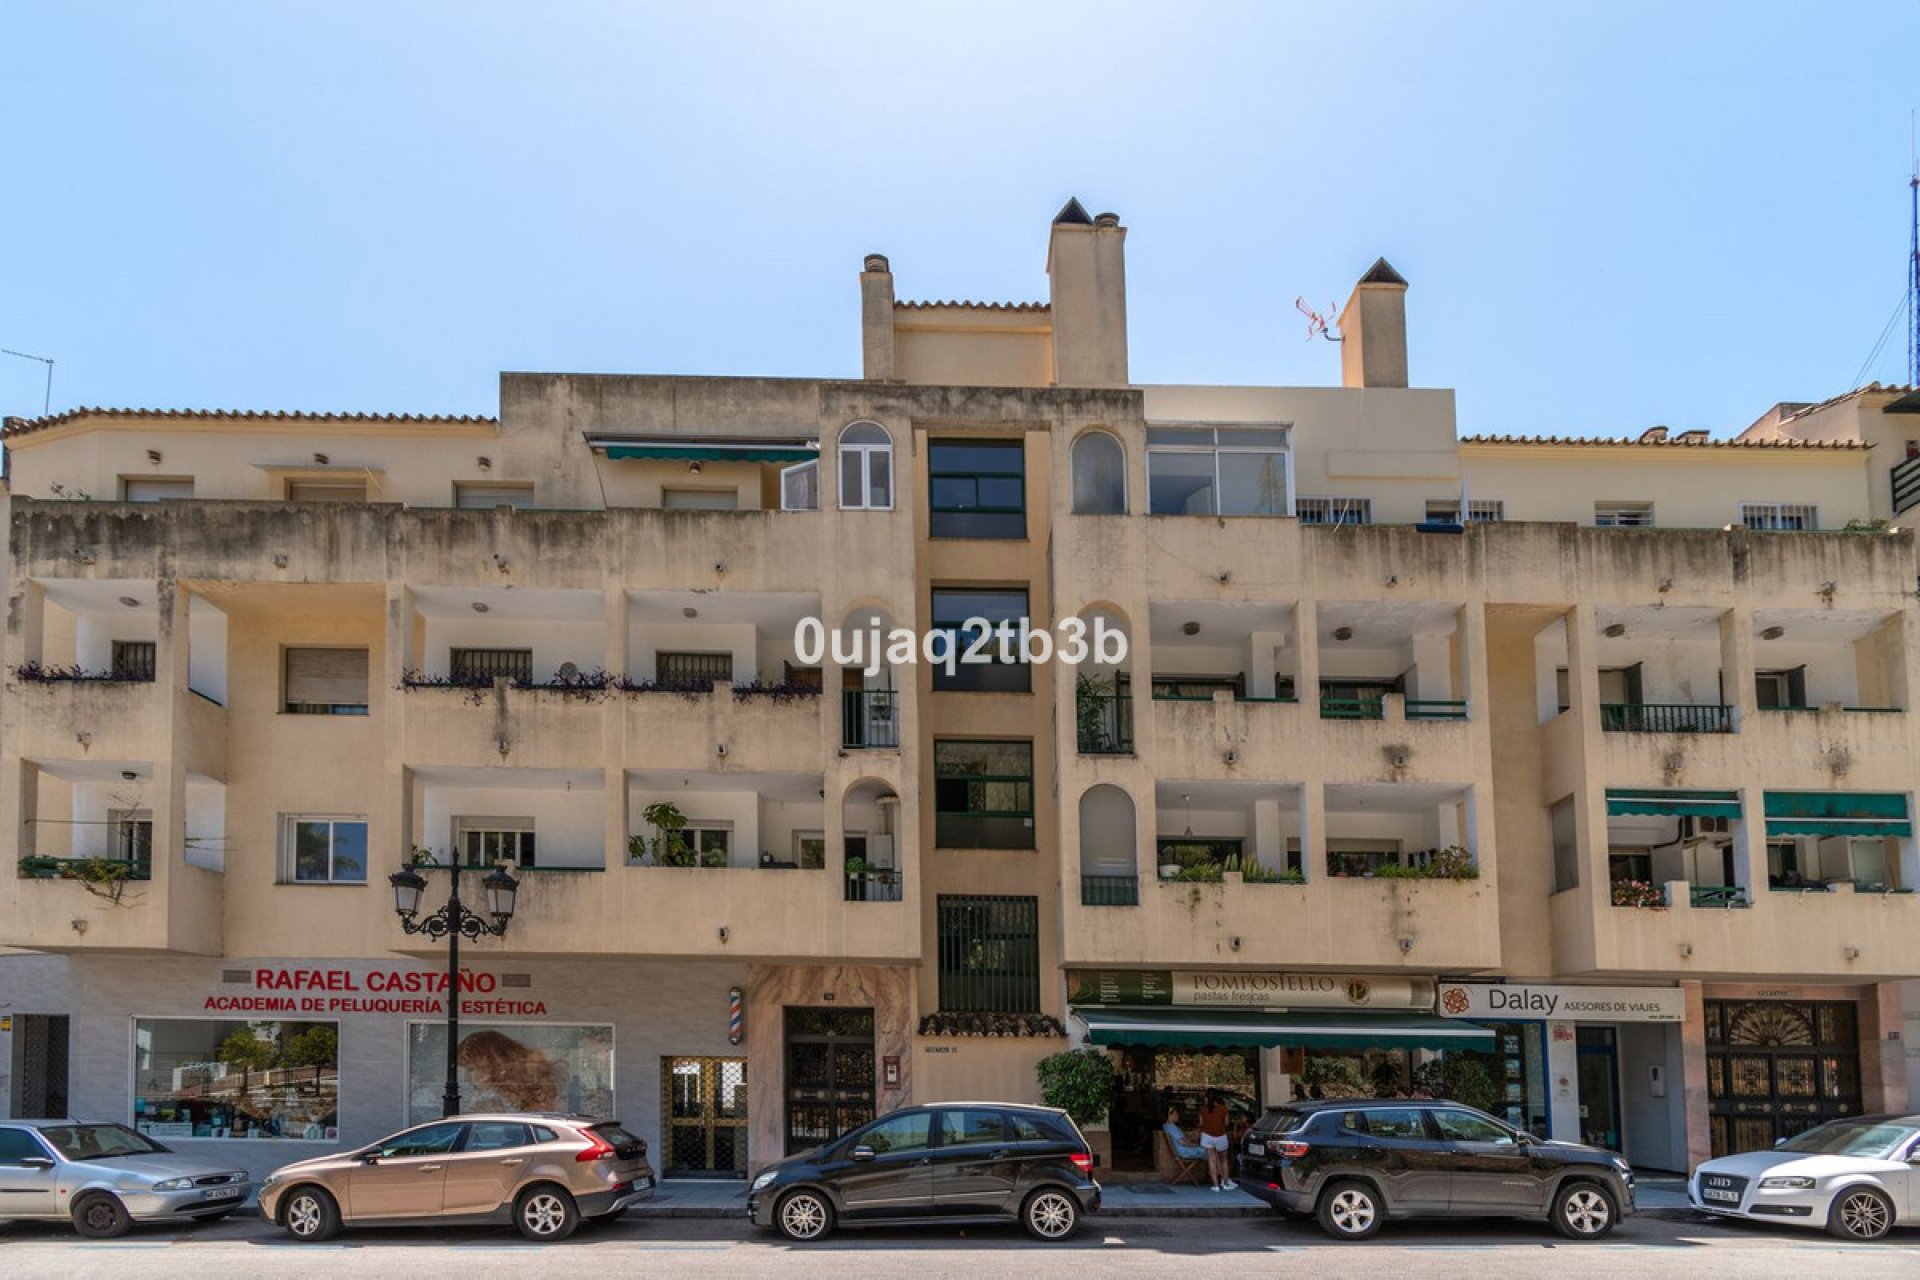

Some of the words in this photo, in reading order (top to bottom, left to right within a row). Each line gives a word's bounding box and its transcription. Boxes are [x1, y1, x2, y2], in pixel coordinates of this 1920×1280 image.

[256, 969, 359, 991] RAFAEL
[366, 968, 496, 993] CASTAÑO
[204, 996, 297, 1011] ACADEMIA
[302, 999, 324, 1012] DE
[329, 997, 442, 1014] PELUQUERÍA
[461, 999, 547, 1015] ESTÉTICA
[1193, 991, 1229, 1002] pastas
[1231, 990, 1270, 1002] frescas
[1489, 989, 1559, 1015] Dalay
[1564, 1002, 1612, 1012] ASESORES
[1614, 1002, 1627, 1012] DE
[1629, 1002, 1661, 1013] VIAJES
